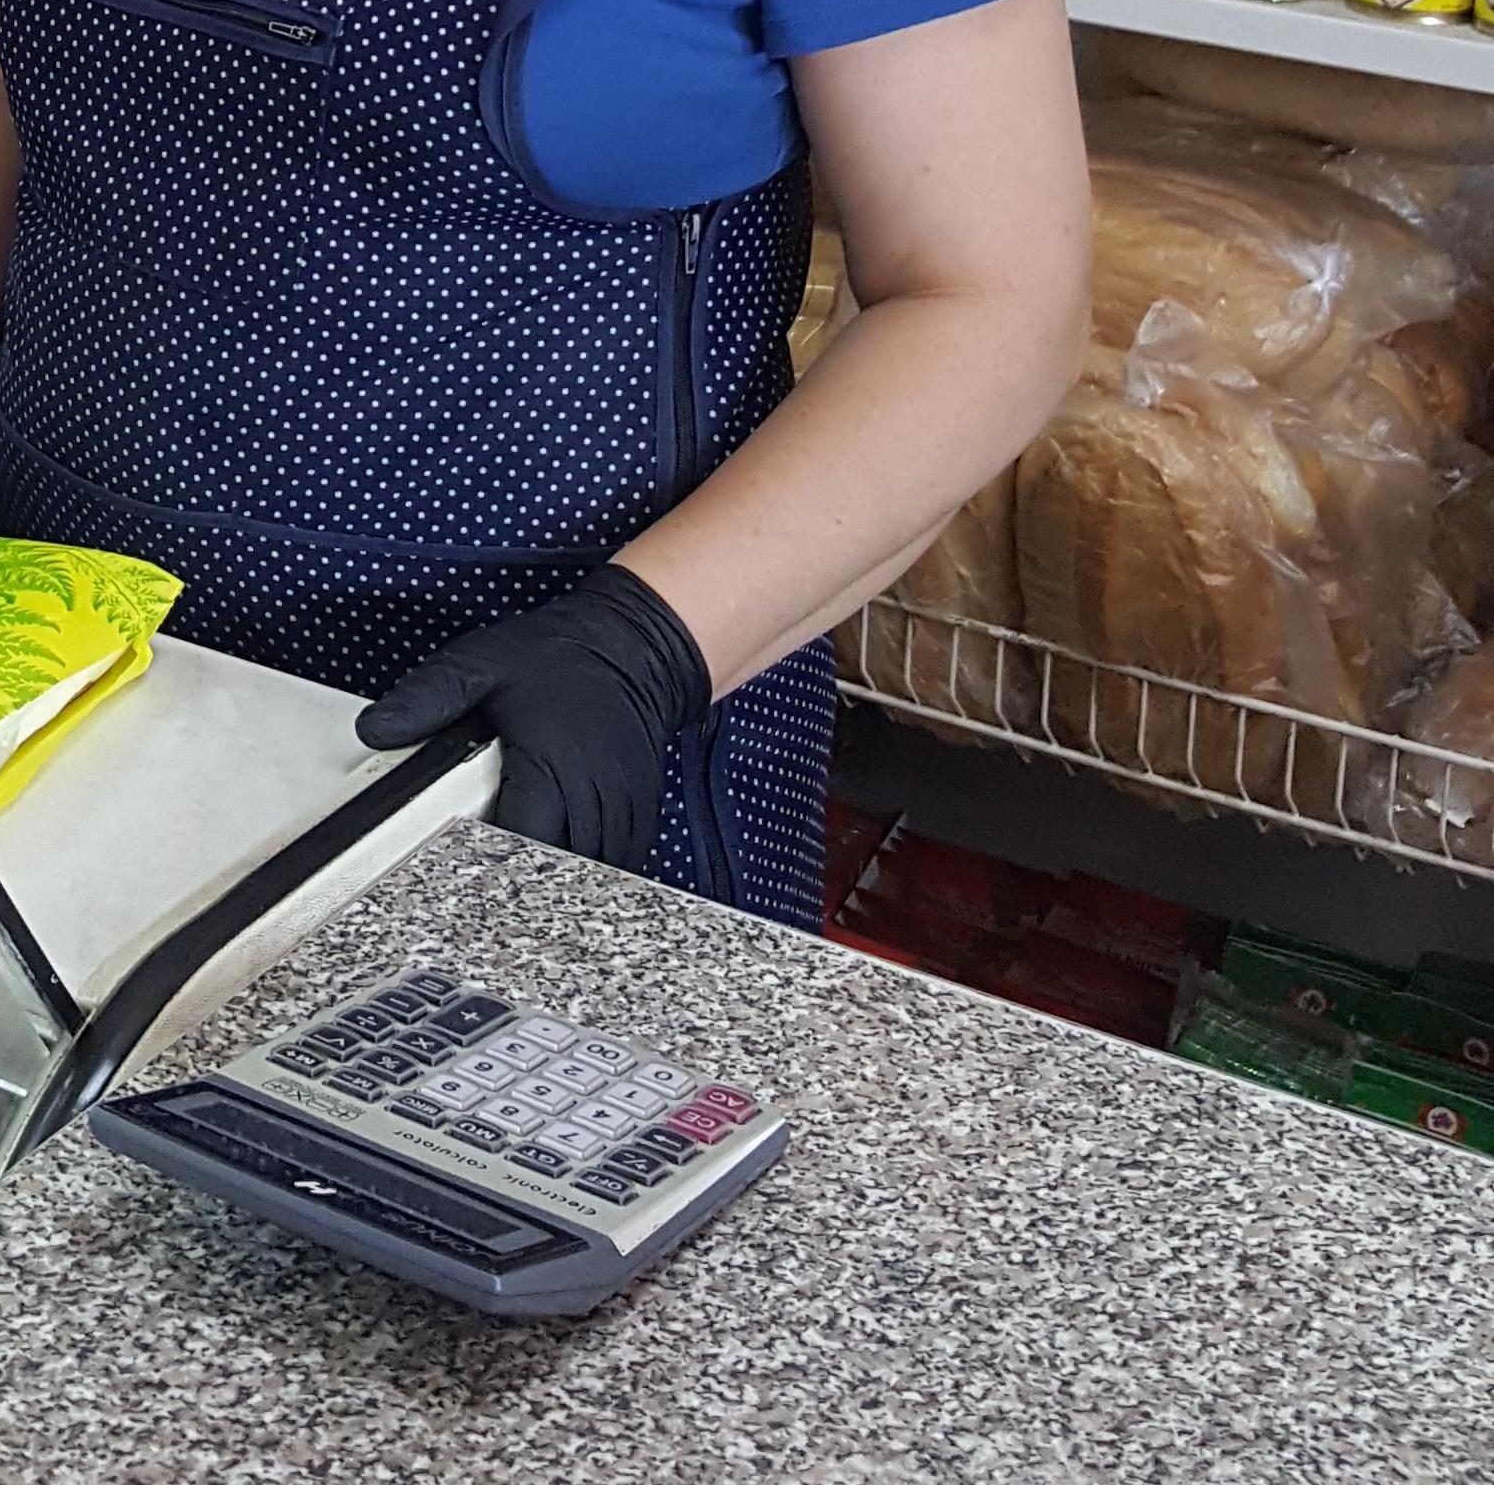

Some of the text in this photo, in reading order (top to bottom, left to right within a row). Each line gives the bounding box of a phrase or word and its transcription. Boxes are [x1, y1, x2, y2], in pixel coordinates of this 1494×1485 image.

[505, 1041, 527, 1055] 3
[473, 1060, 495, 1074] 6
[561, 1064, 585, 1078] 2
[440, 1080, 463, 1094] 9
[529, 1083, 553, 1097] 5
[707, 1090, 746, 1110] AC
[498, 1104, 521, 1118] 8
[680, 1110, 717, 1130] CE
[556, 1130, 581, 1144] 7
[391, 1128, 598, 1217] Electronic calculator
